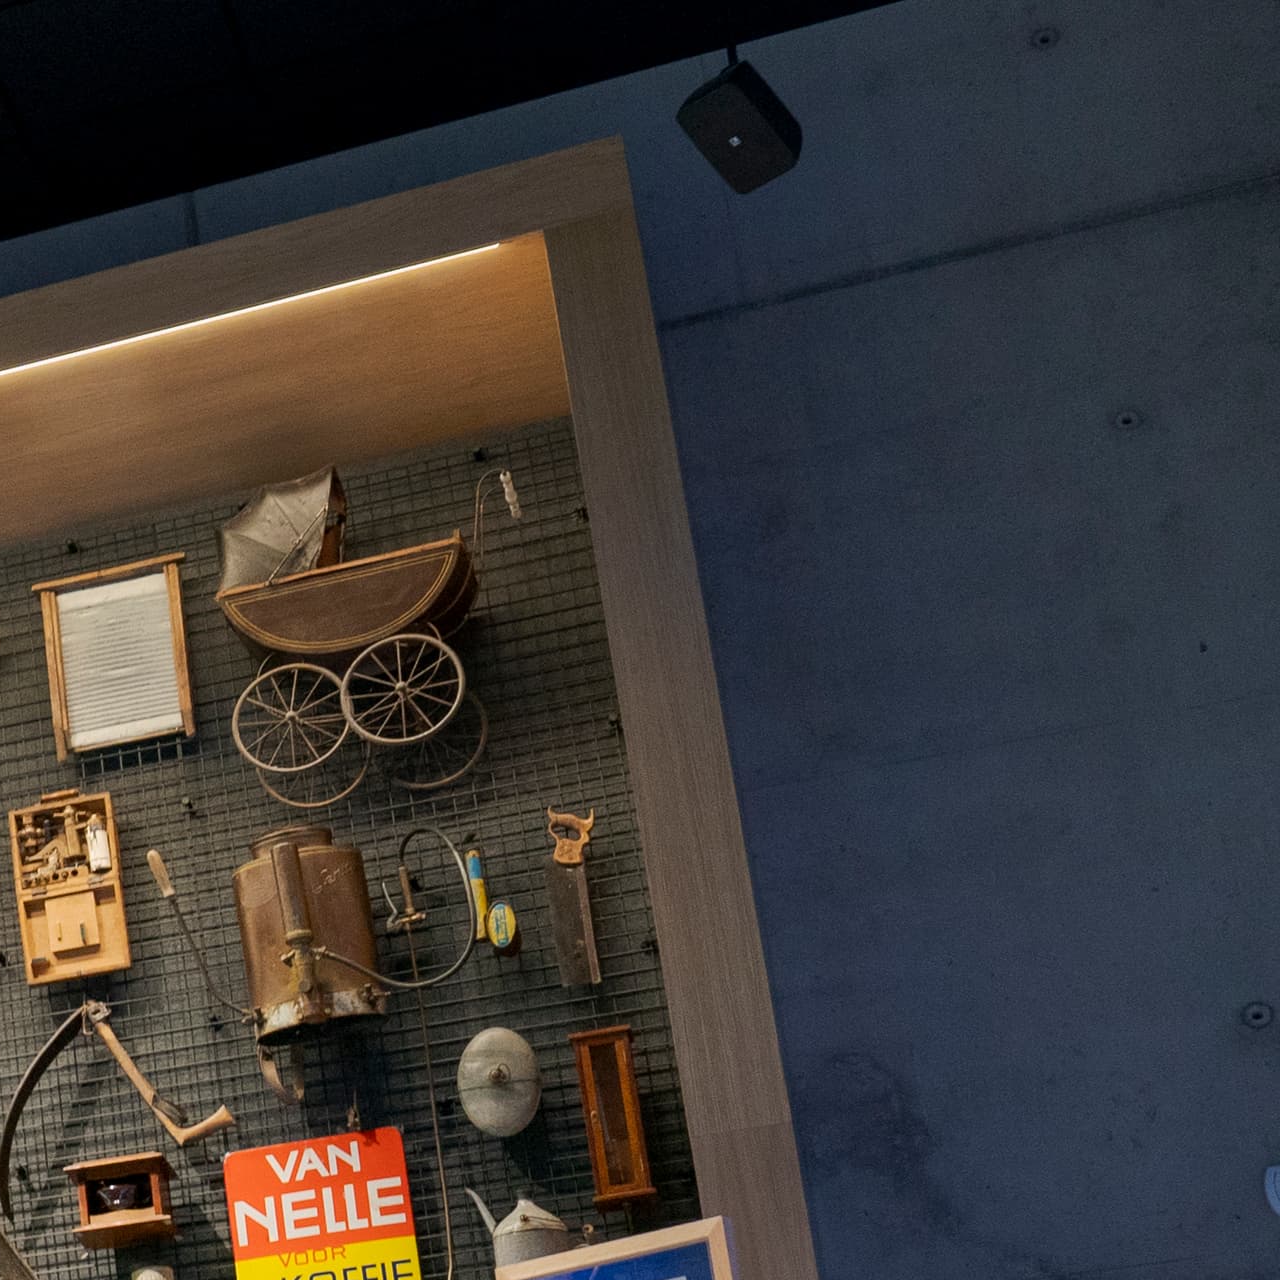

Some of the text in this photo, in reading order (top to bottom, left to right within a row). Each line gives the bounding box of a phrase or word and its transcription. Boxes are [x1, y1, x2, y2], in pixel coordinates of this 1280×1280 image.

[265, 1140, 361, 1184] VAN
[233, 1175, 407, 1248] NELLE
[278, 1246, 347, 1268] VOOR
